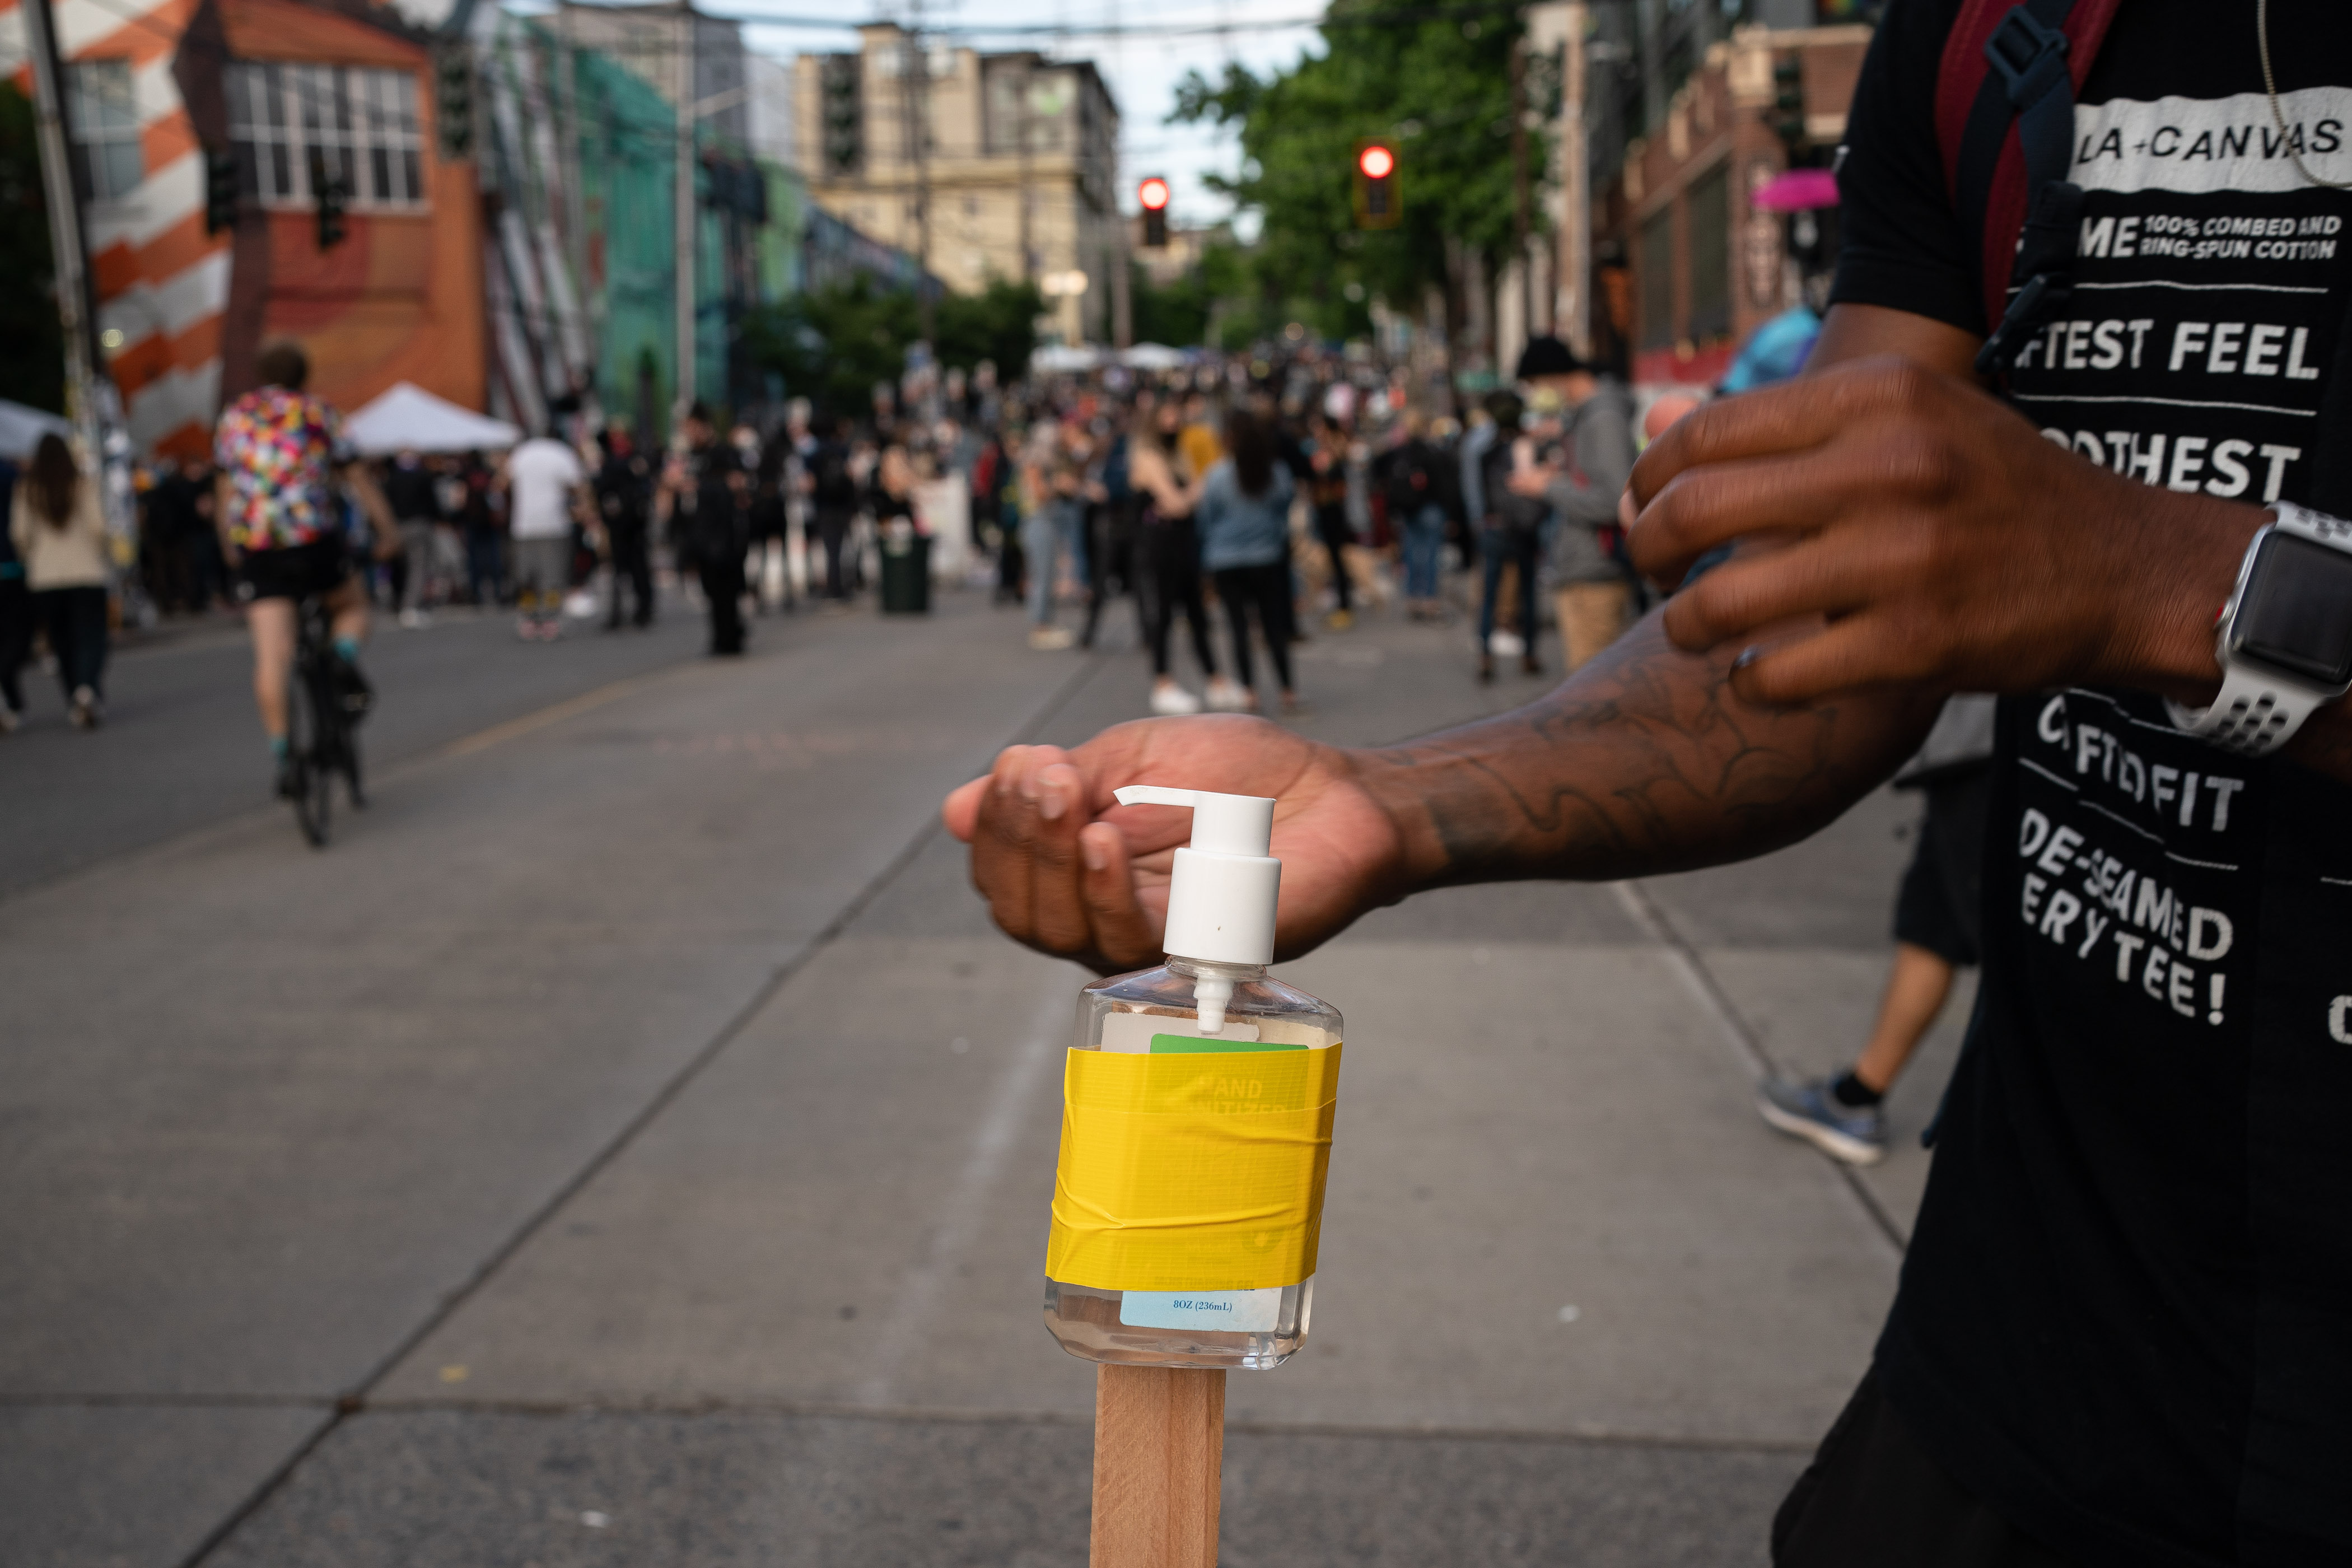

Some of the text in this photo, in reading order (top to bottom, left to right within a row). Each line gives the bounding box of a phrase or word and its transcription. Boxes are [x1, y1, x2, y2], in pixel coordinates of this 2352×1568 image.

[2139, 237, 2337, 260] RING-SPUN COTTON
[2145, 214, 2342, 237] 100% COMBED AND
[2168, 321, 2320, 380] FEEL
[2150, 763, 2246, 833] FIT
[2018, 807, 2234, 961] DE-SEAMED
[2113, 930, 2227, 1026] TEE!
[1195, 1301, 1233, 1313] (236mL)
